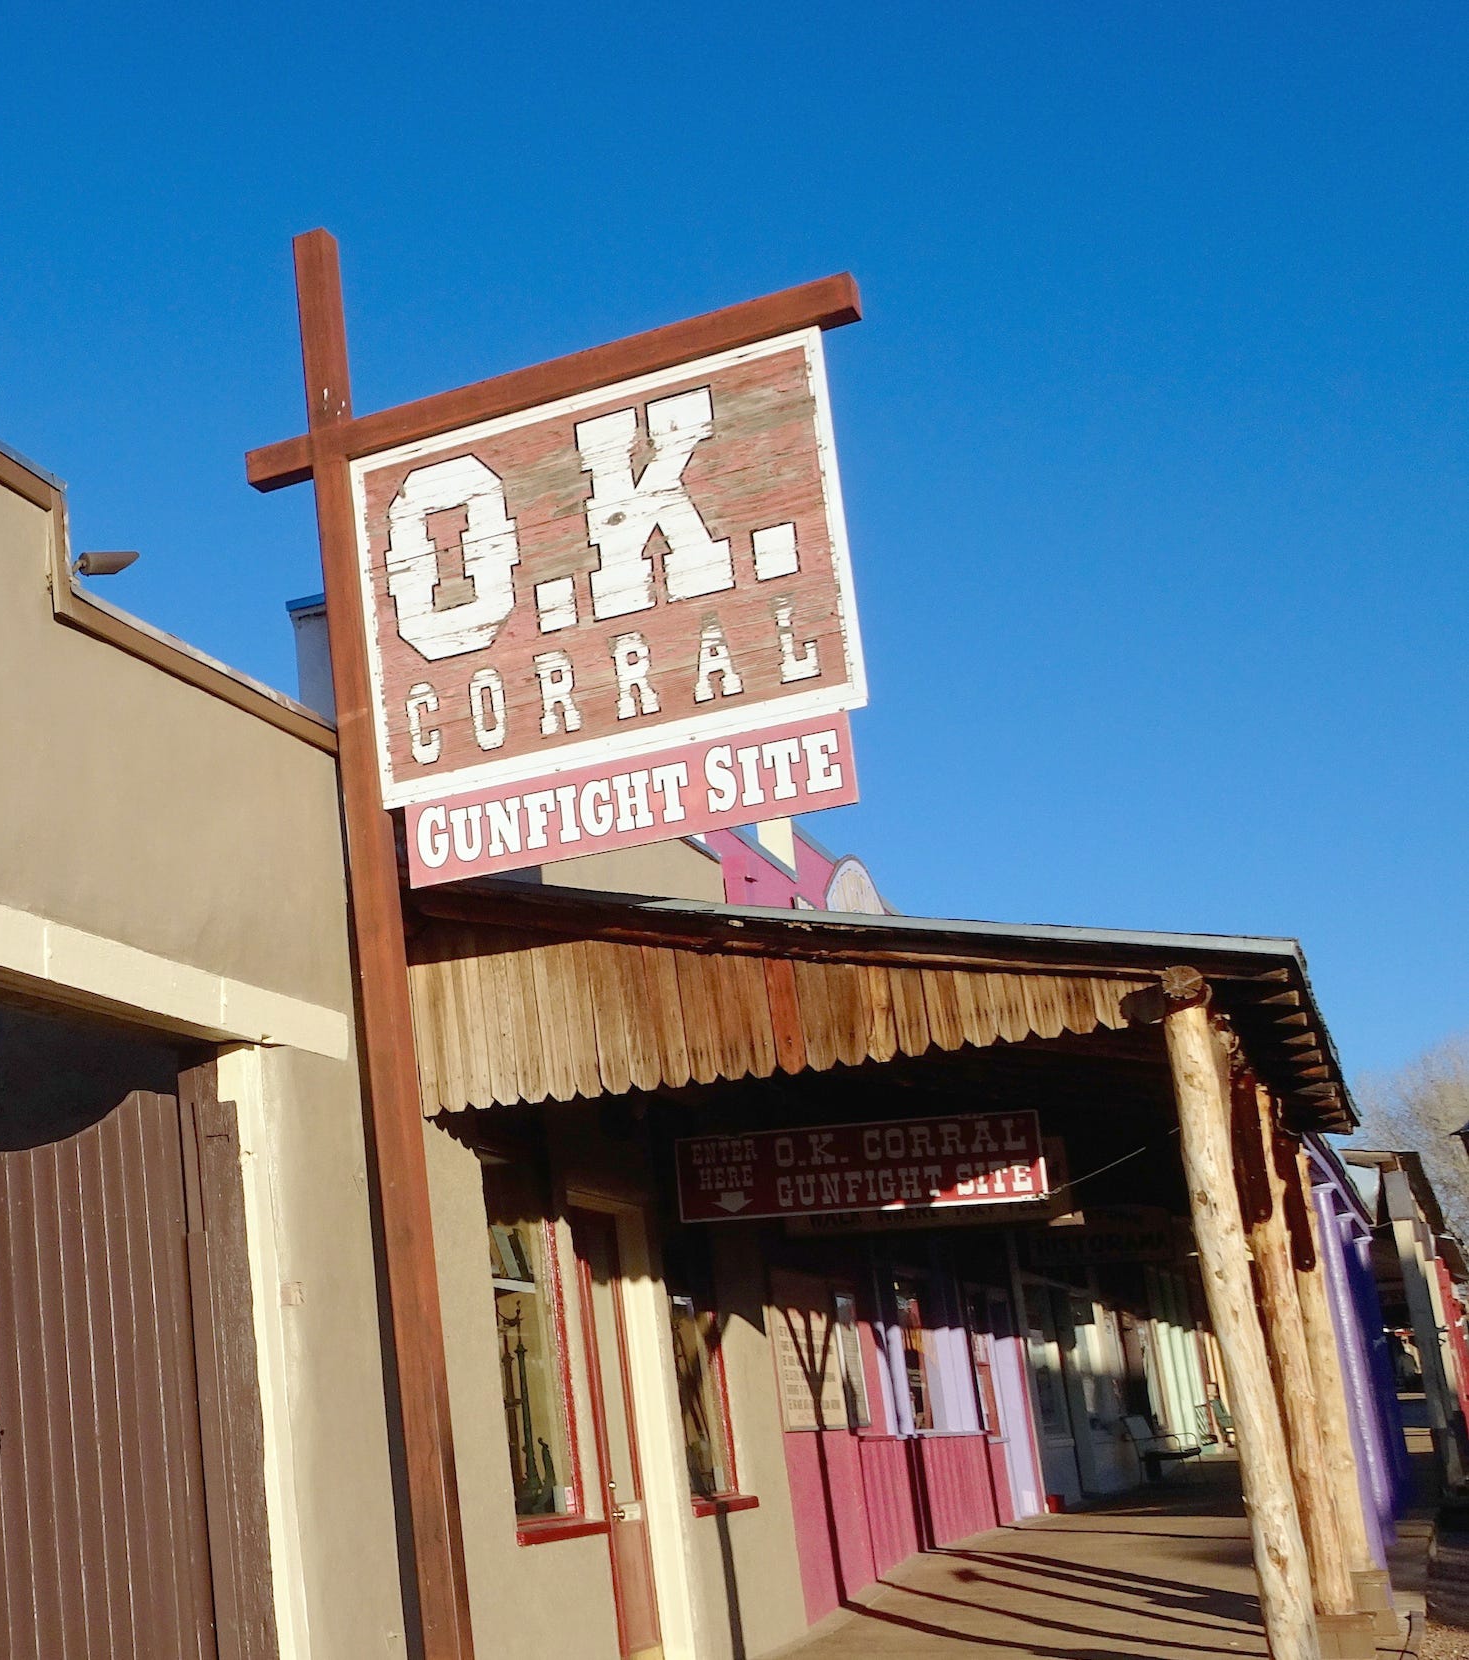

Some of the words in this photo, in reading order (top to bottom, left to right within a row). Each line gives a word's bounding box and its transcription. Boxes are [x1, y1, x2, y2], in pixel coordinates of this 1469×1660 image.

[384, 384, 801, 662] O.K.
[405, 595, 822, 765] CORRAL
[417, 761, 688, 868] GUNFIGHT
[703, 728, 844, 813] SITE
[691, 1138, 758, 1165] ENTER
[862, 1118, 1027, 1161] CORRAL
[698, 1165, 754, 1191] HERE
[776, 1165, 943, 1208] GUNFIGHT
[955, 1159, 1033, 1197] SITE
